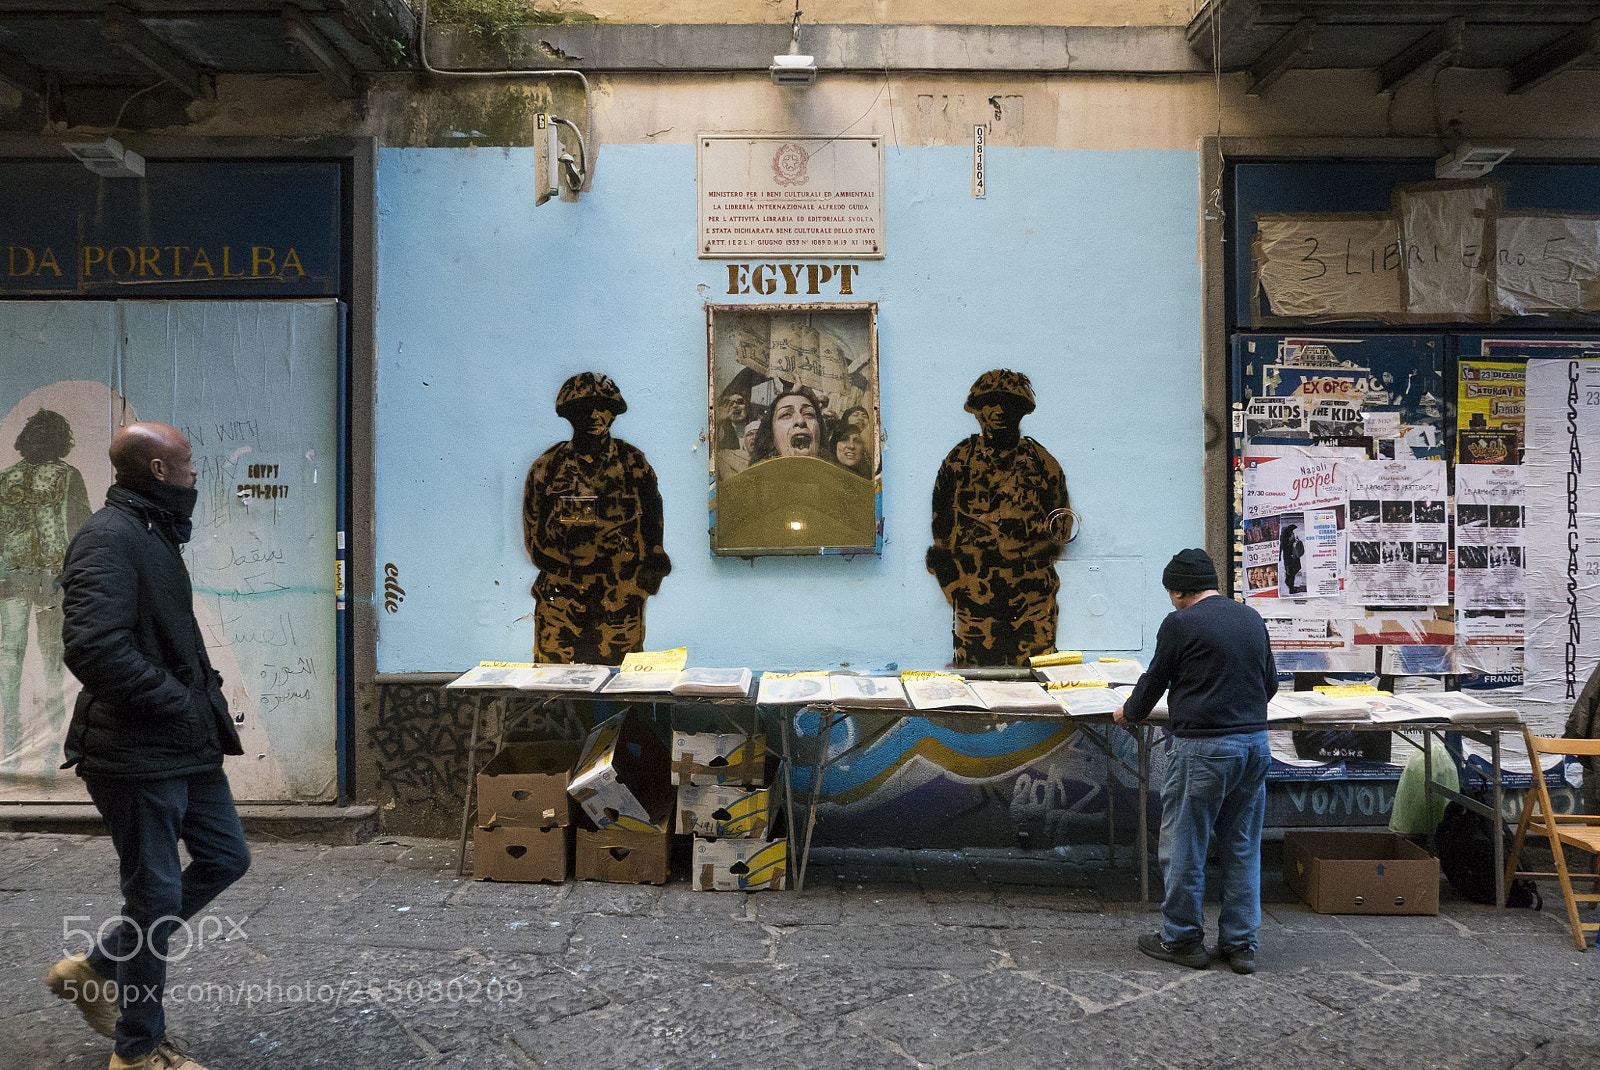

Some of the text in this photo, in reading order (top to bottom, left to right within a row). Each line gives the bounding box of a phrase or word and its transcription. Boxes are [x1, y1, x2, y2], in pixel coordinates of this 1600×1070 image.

[83, 246, 307, 277] PORTALBA
[1301, 237, 1327, 281] 3
[1344, 239, 1438, 275] LIBRI
[726, 264, 859, 295] EGYPT
[1303, 380, 1320, 394] EX
[1586, 392, 1600, 405] 23
[1249, 405, 1300, 418] THE KIDS
[1313, 408, 1328, 416] THE
[1332, 408, 1364, 422] KIDS
[1566, 361, 1582, 529] CASSANDRA
[248, 464, 279, 478] EGYPT
[1290, 462, 1338, 501] gospel
[1300, 462, 1327, 475] Napoli
[384, 562, 406, 615] edie
[1566, 532, 1580, 700] CASSANDRA
